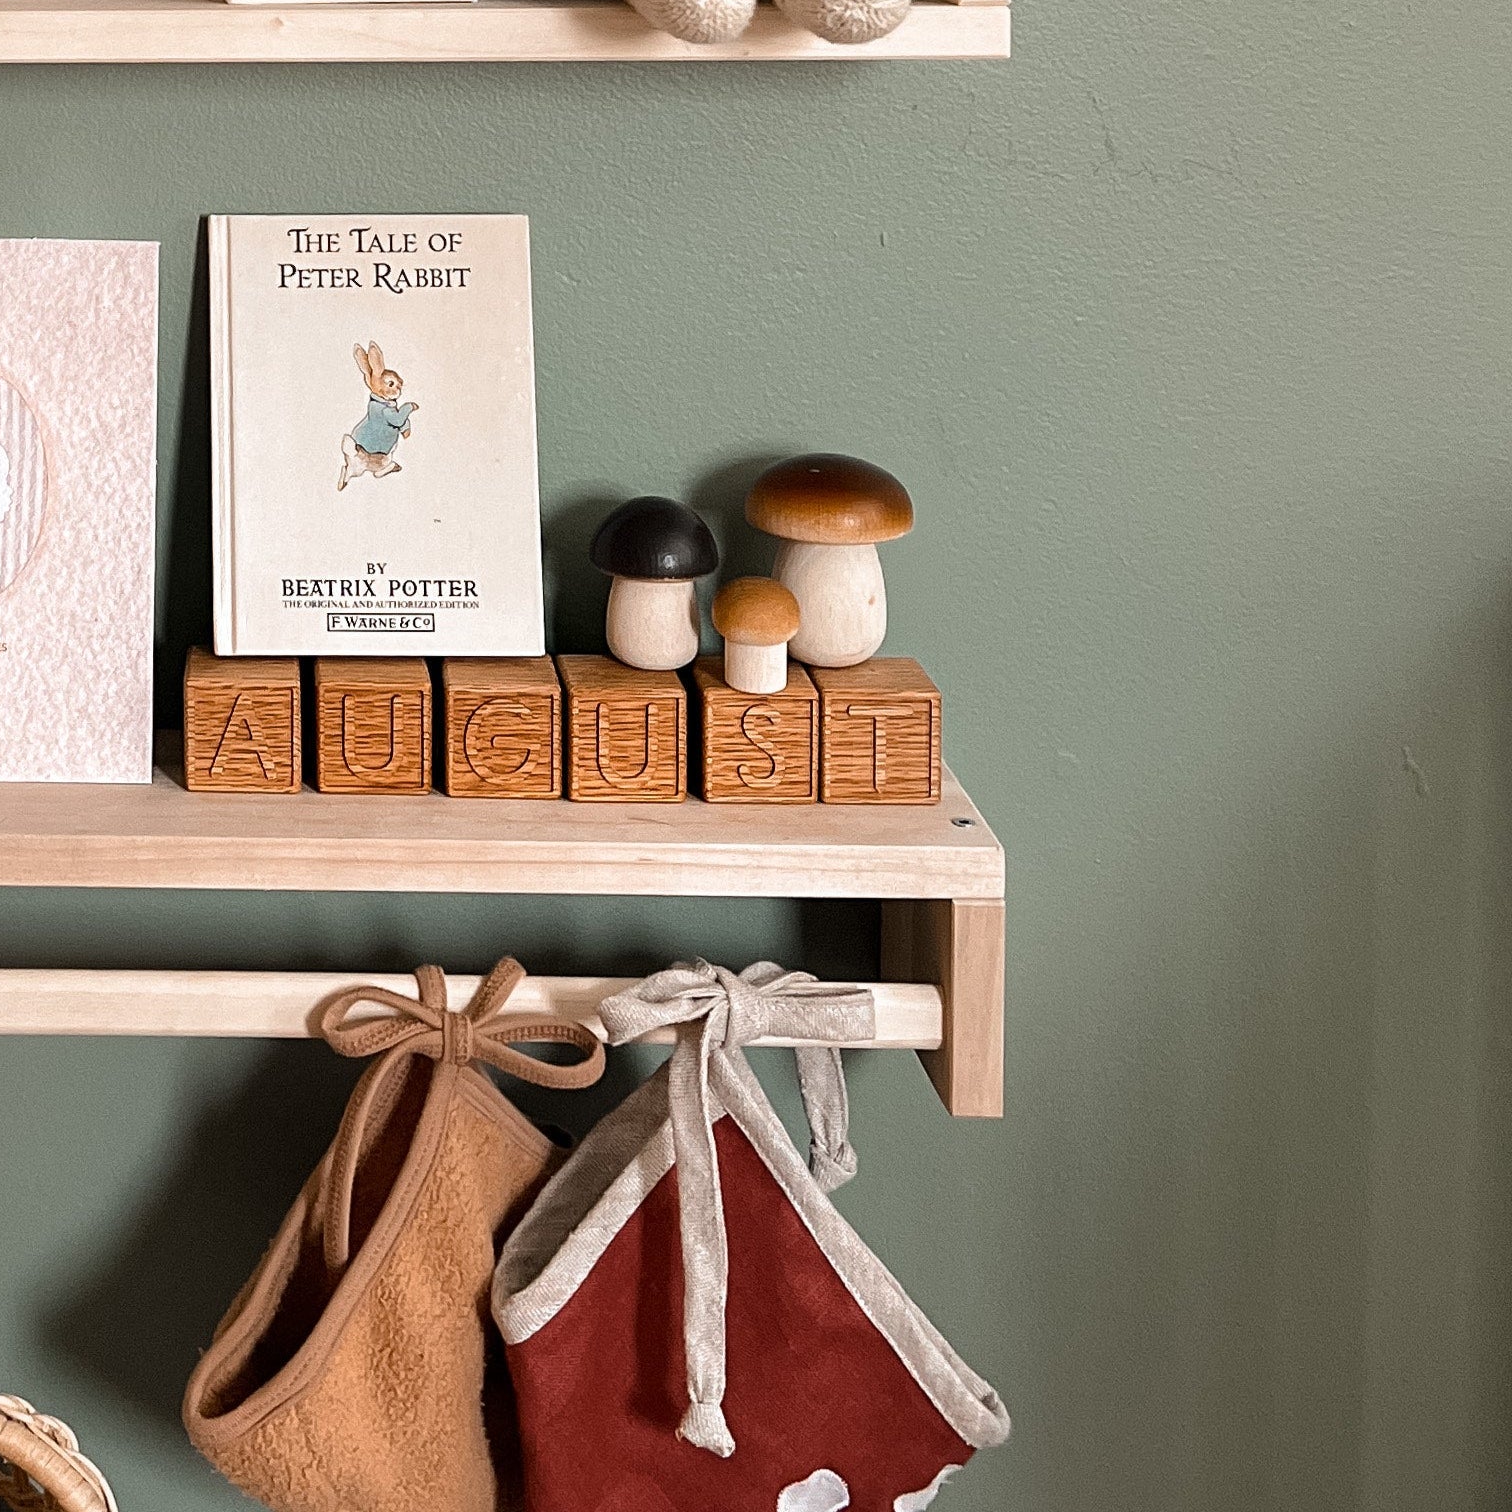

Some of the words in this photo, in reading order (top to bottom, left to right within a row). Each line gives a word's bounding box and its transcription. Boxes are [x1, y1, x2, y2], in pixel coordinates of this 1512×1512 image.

[287, 226, 341, 253] THE
[349, 226, 418, 253] TALE
[428, 232, 463, 253] OF
[277, 263, 363, 288] PETER
[372, 262, 472, 294] RABBIT
[367, 563, 387, 574] BY
[281, 579, 377, 597] BEATRIX
[388, 579, 479, 597] POTTER
[282, 600, 302, 608] THE
[304, 600, 351, 608] ORIGINAL
[352, 600, 374, 608] AND
[375, 600, 438, 609] AUTHORIZED
[439, 600, 480, 609] EDITION
[344, 616, 397, 629] WARNE
